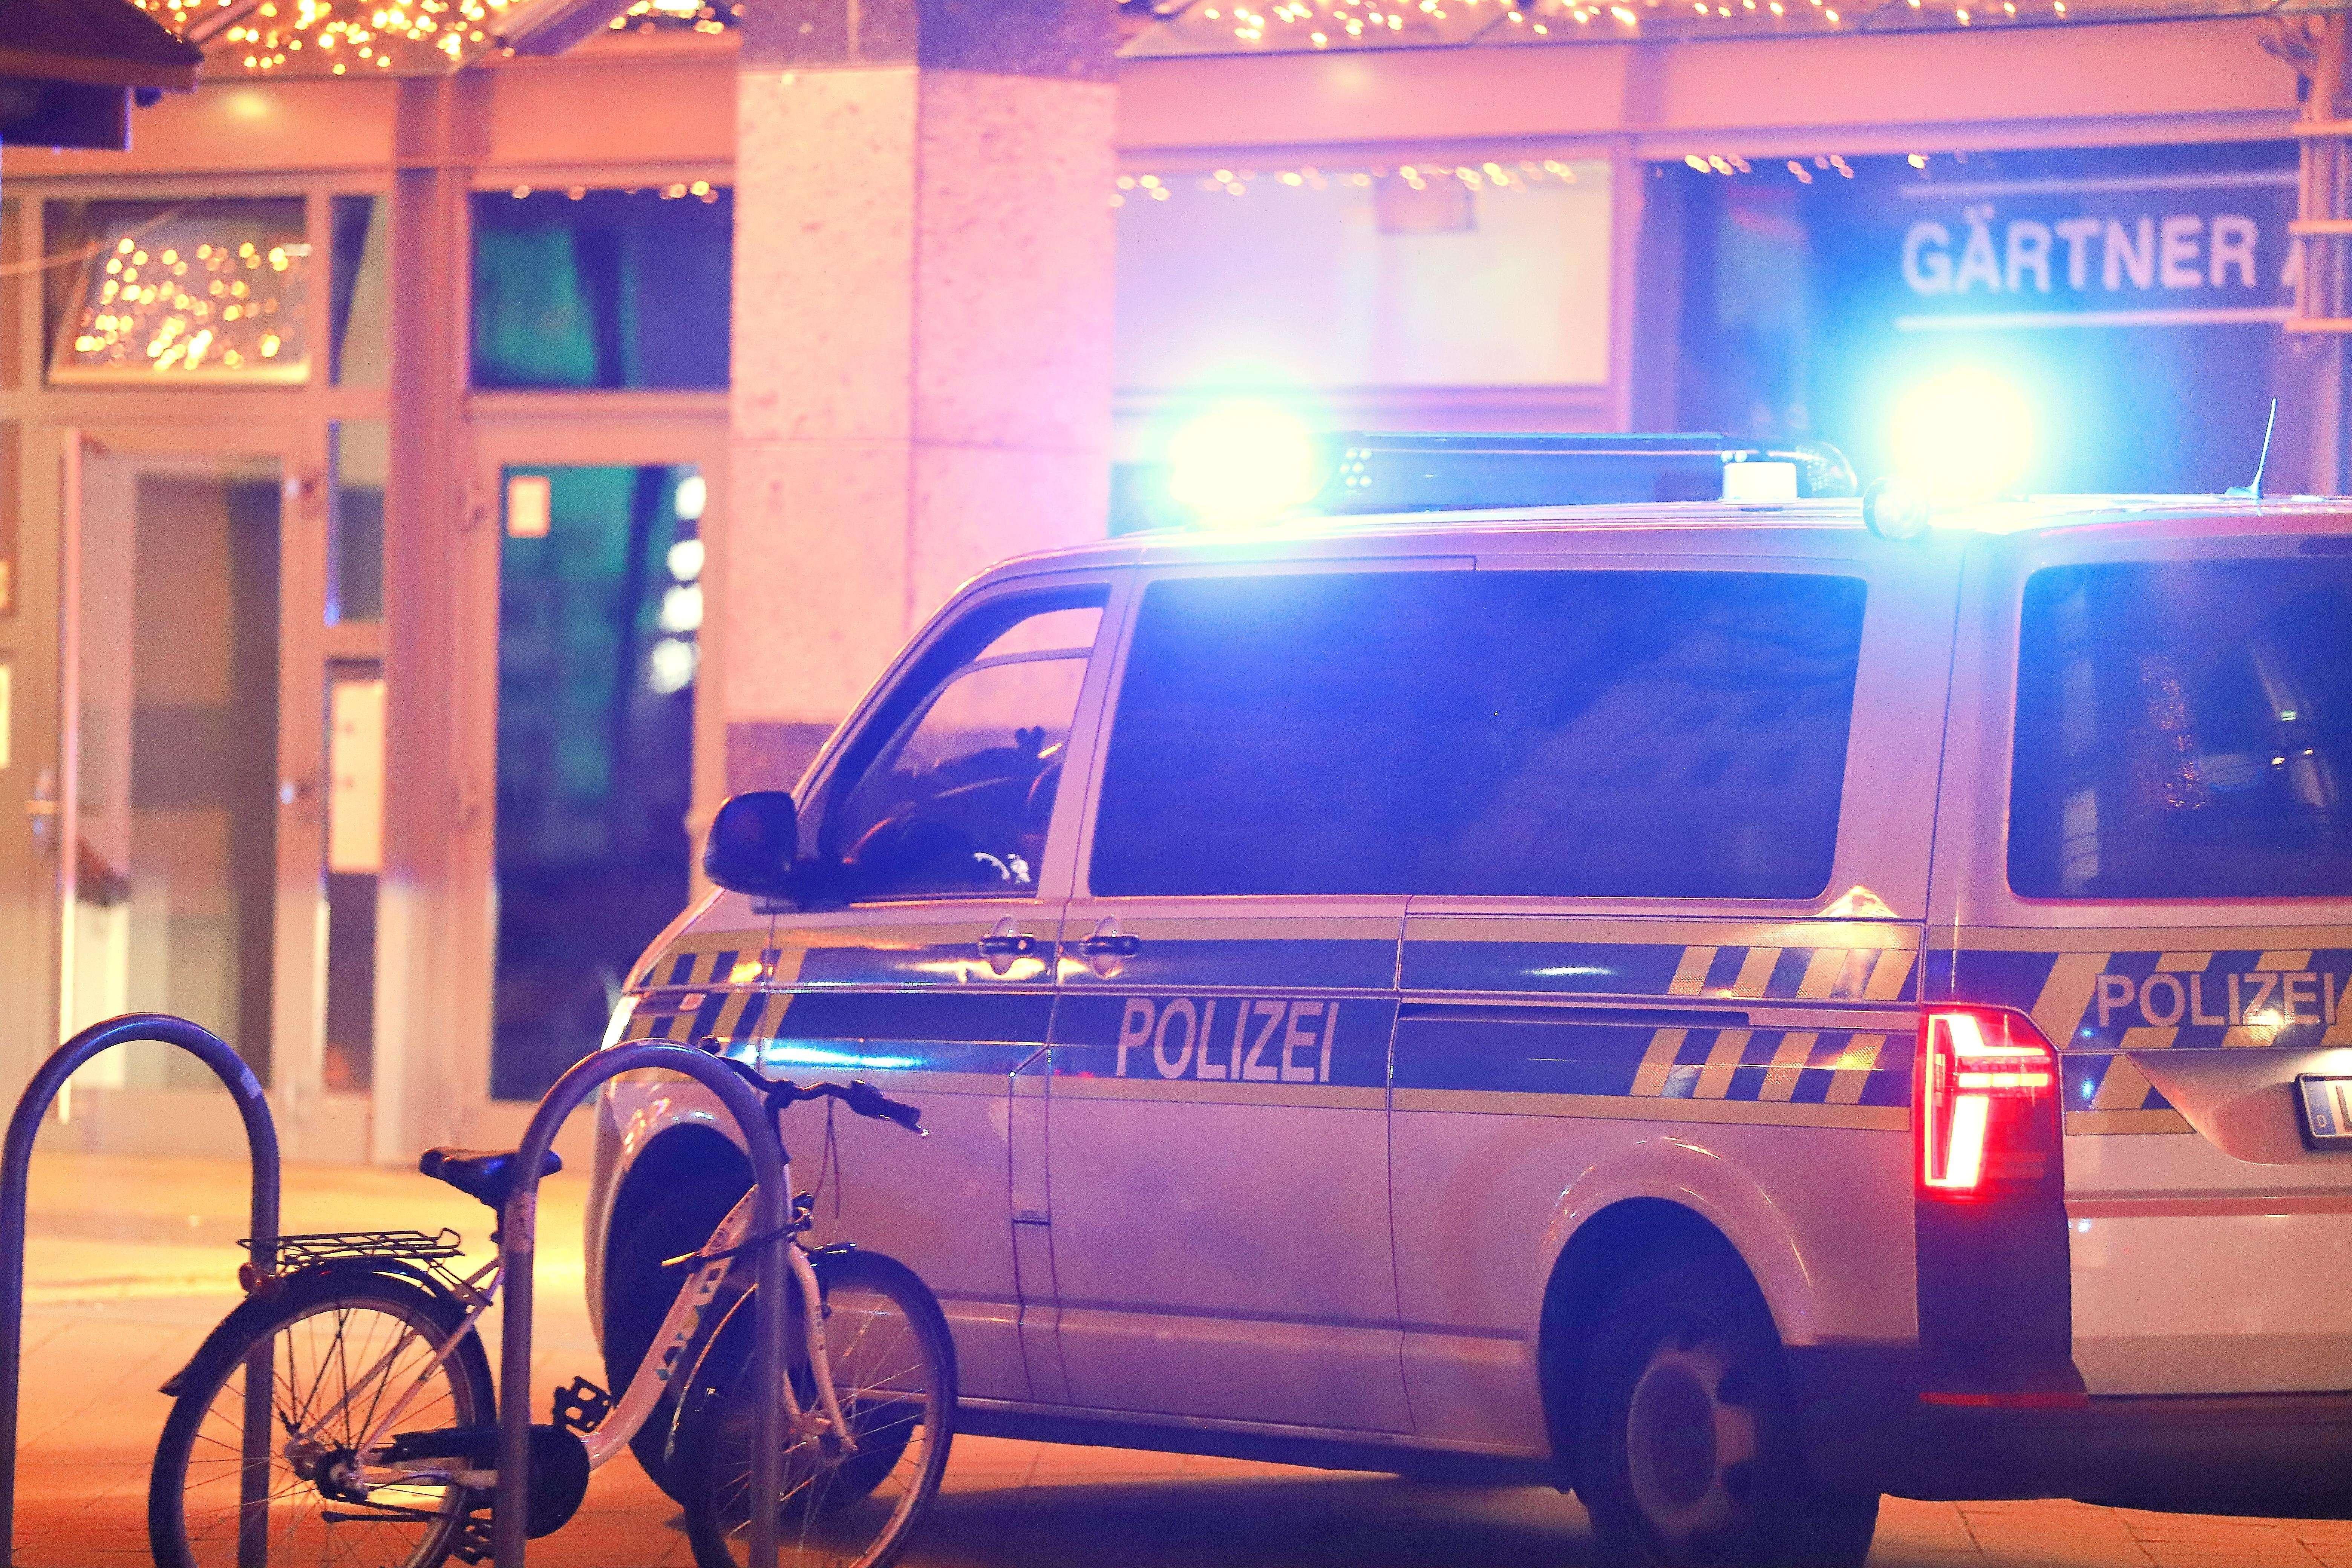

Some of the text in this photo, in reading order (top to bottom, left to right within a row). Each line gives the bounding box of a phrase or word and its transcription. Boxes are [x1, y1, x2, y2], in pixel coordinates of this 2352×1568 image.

[1902, 204, 2258, 293] GÄRTNER
[2097, 972, 2336, 1027] POLIZEI
[1116, 998, 1339, 1082] POLIZEI
[2316, 1114, 2327, 1128] D
